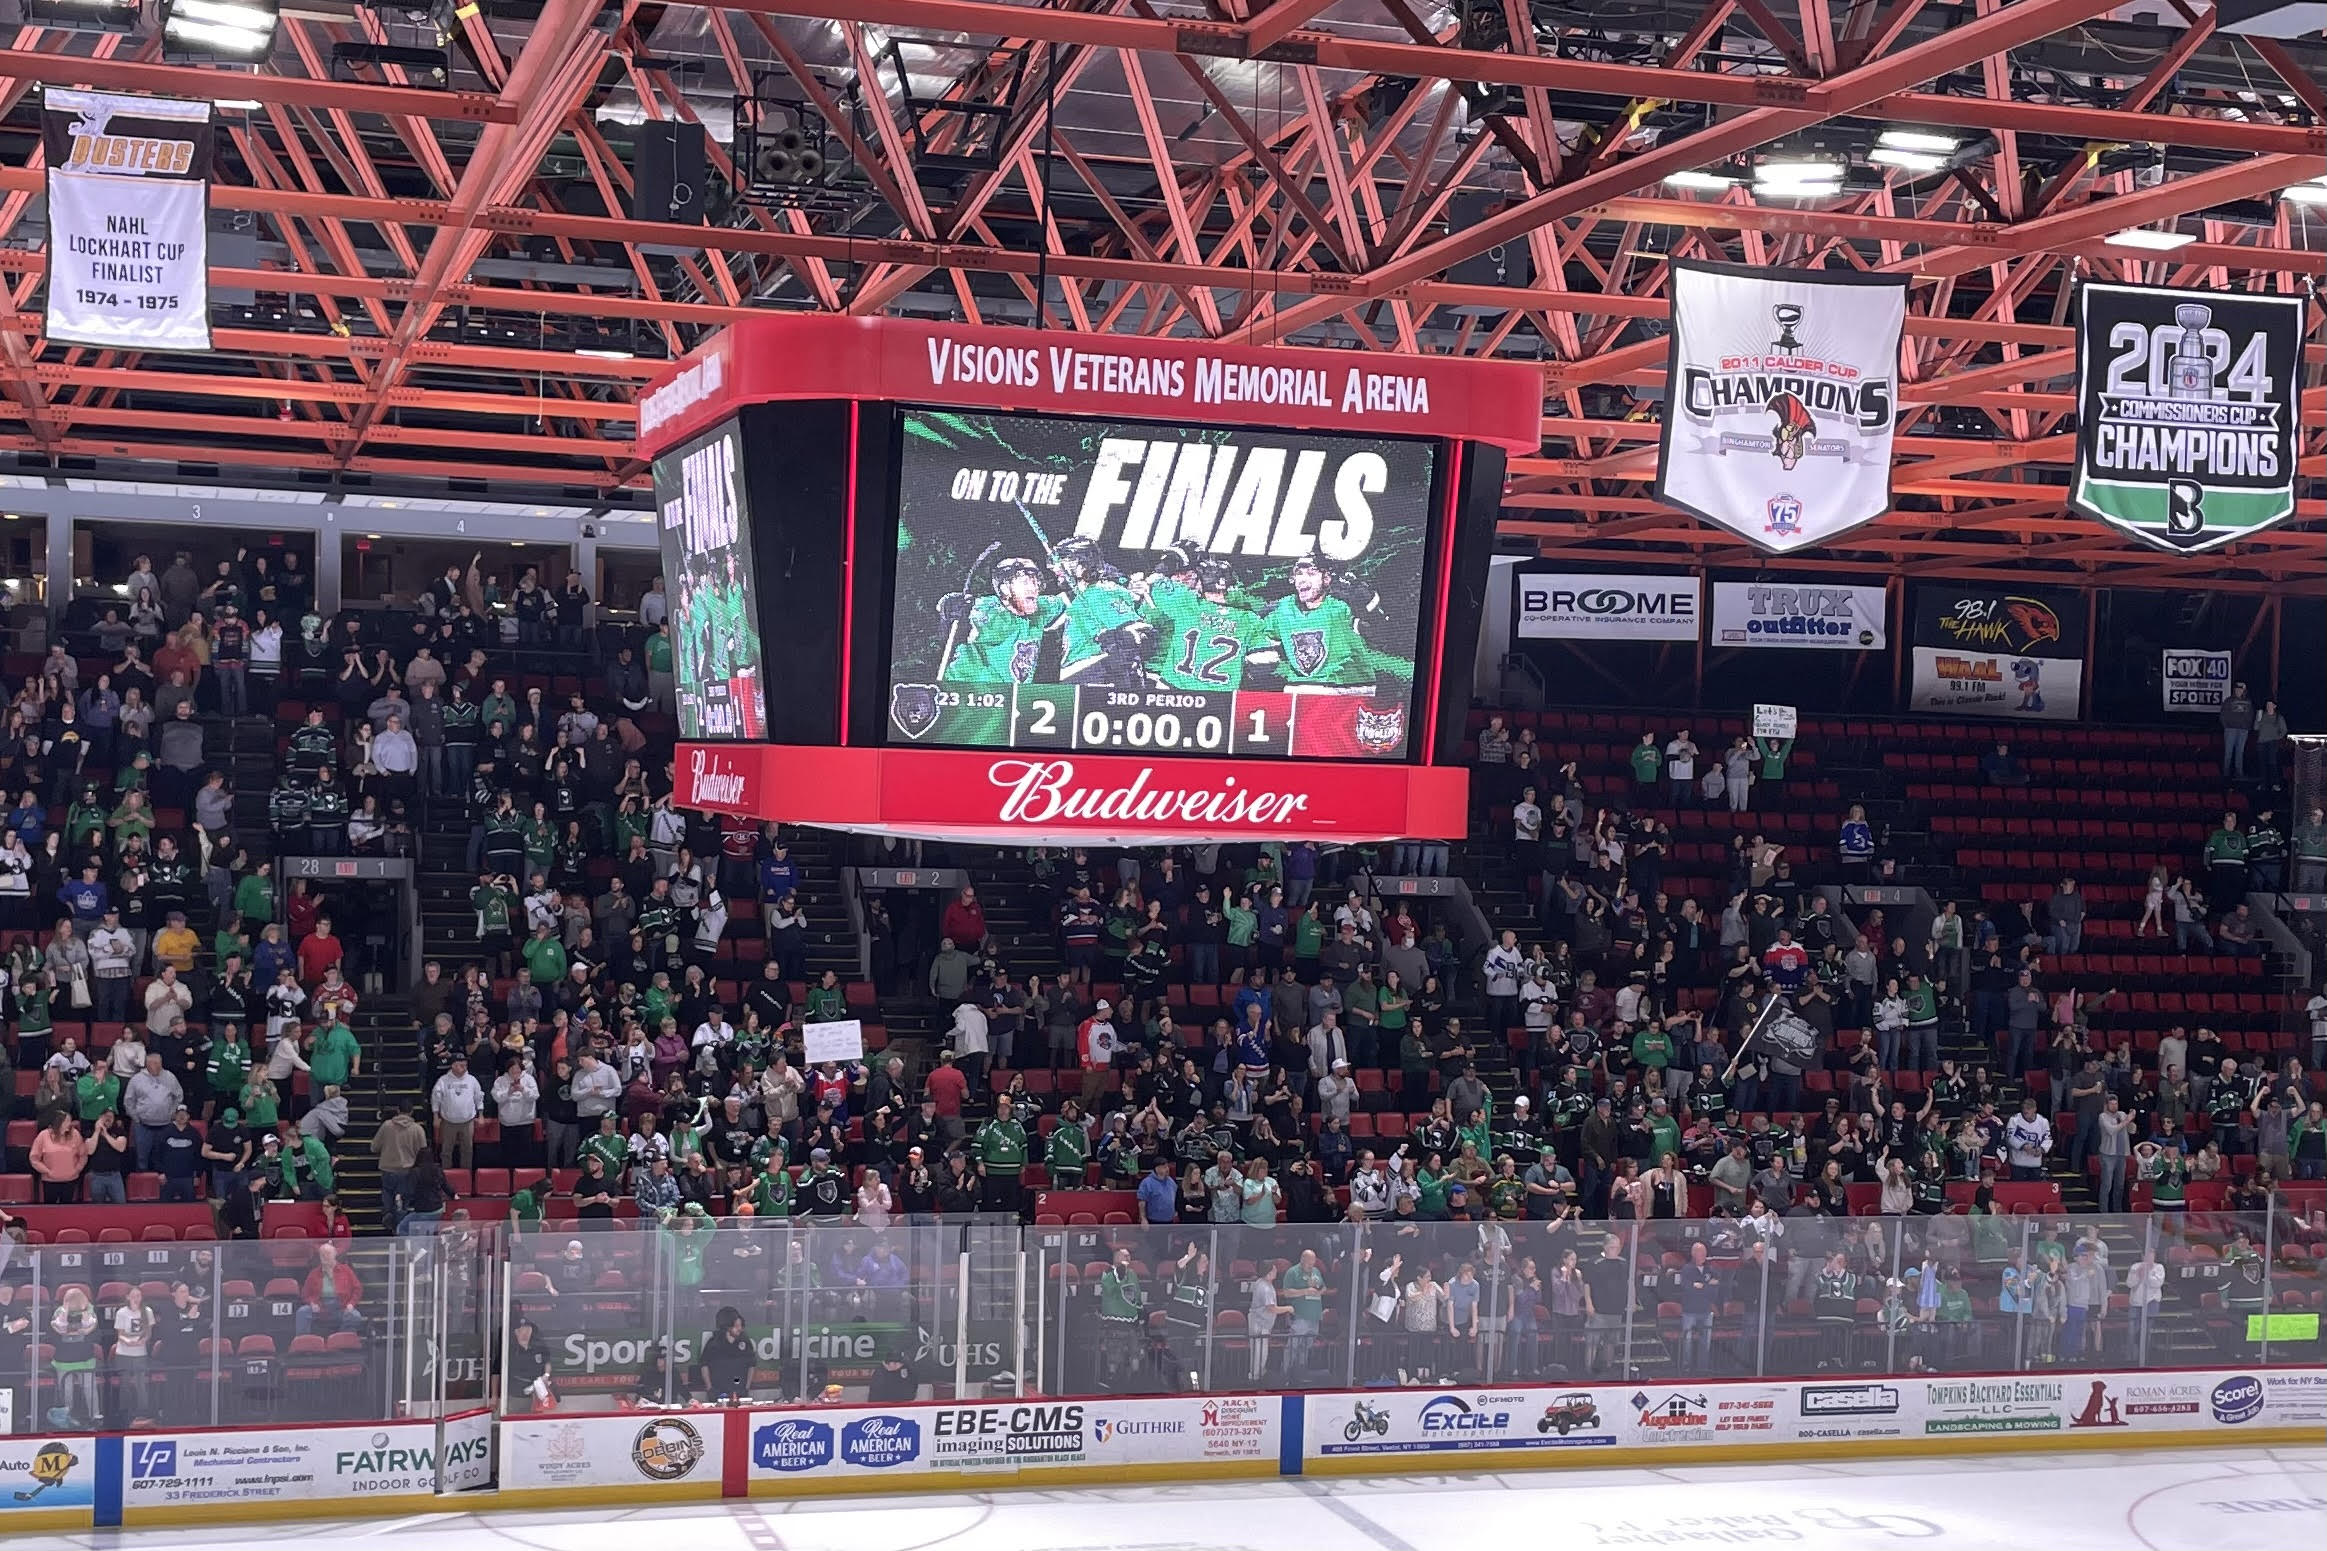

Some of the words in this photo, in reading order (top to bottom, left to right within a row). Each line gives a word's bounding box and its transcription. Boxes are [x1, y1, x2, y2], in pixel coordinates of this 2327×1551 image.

[71, 135, 194, 171] DUSTERS
[107, 215, 149, 235] NAHL
[70, 235, 152, 257] LOCKHART
[157, 243, 185, 261] CUP
[92, 263, 163, 284] FINALIST
[76, 289, 118, 307] 1974
[137, 296, 178, 310] 1975
[1720, 356, 1760, 370] 2011
[1765, 356, 1824, 372] CALDER
[1828, 363, 1858, 378] CUP
[2106, 321, 2273, 404] 2024
[927, 337, 1040, 389] VISIONS
[1048, 345, 1186, 399] VETERANS
[1194, 355, 1333, 407] MEMORIAL
[1341, 366, 1430, 414] ARENA
[1685, 367, 1890, 427] CHAMPIONS
[2120, 399, 2228, 424] COMMISSIONERS
[2230, 408, 2257, 425] CUP
[2096, 424, 2279, 477] CHAMPIONS
[951, 467, 988, 501] ON
[988, 469, 1019, 502] TO
[1022, 472, 1068, 505] THE
[1075, 438, 1388, 560] FINALS
[192, 504, 201, 519] 3
[1772, 502, 1798, 524] 75
[456, 519, 465, 533] 4
[1524, 589, 1694, 615] BROOME
[1747, 587, 1854, 618] TRUX
[1954, 599, 1998, 620] 98.1
[1524, 614, 1592, 624] CO-OPERATIVE
[1595, 616, 1646, 624] INSURANCE
[1746, 616, 1852, 637] outfitter
[1938, 616, 1961, 629] THE
[1953, 618, 2013, 648] HAWK
[1174, 627, 1242, 684] 12
[2167, 657, 2203, 677] FOX
[2206, 659, 2227, 678] 40
[1950, 681, 1969, 692] 99.1
[1972, 681, 1986, 692] FM
[967, 693, 1005, 707] 1:02
[1107, 693, 1139, 706] 3RD
[1146, 695, 1206, 708] PERIOD
[2171, 691, 2220, 704] SPORTS
[1029, 699, 1056, 735] 2
[1247, 709, 1270, 743] 1
[1082, 711, 1222, 749] 0:00.0
[691, 749, 745, 805] Budweiser
[988, 759, 1308, 824] Budweiser
[301, 859, 320, 875] 28
[377, 861, 385, 876] 1
[871, 870, 878, 885] 1
[931, 871, 940, 886] 2
[1431, 879, 1439, 894] 3
[1893, 889, 1900, 903] 4
[2052, 1183, 2060, 1193] 3
[1038, 1193, 1047, 1204] 2
[68, 1255, 75, 1266] 9
[109, 1254, 120, 1264] 10
[2266, 1377, 2287, 1385] Work
[2287, 1377, 2299, 1385] for
[2300, 1376, 2313, 1384] NY
[1927, 1382, 1968, 1405] TOMPKINS
[1970, 1382, 2012, 1403] BACKYARD
[2014, 1382, 2063, 1402] ESSENTIALS
[2126, 1386, 2166, 1398] ROMAN
[2169, 1385, 2200, 1395] ACRES
[2214, 1380, 2260, 1405] Score!
[1982, 1405, 2012, 1414] LLC
[861, 1418, 901, 1439] Real
[934, 1405, 1084, 1436] EBE-CMS
[1116, 1419, 1185, 1435] GUTHRIE
[1928, 1422, 2003, 1433] LANDSCAPING
[2015, 1420, 2058, 1430] MOWING
[774, 1422, 815, 1443] Real
[763, 1441, 825, 1458] AMERICAN
[850, 1437, 912, 1454] AMERICAN
[936, 1436, 1004, 1455] imaging
[1006, 1434, 1082, 1451] SOLUTIONS
[0, 1460, 31, 1471] Auto
[40, 1455, 60, 1473] M
[194, 1457, 244, 1467] Mechanical
[247, 1455, 301, 1465] Contractors
[781, 1457, 807, 1467] BEER
[868, 1453, 893, 1463] BEER
[132, 1477, 213, 1490] 607-729-1111
[352, 1478, 411, 1492] INDOOR
[165, 1491, 180, 1500] 33
[182, 1489, 240, 1500] FREDERICK
[242, 1487, 281, 1497] STREET
